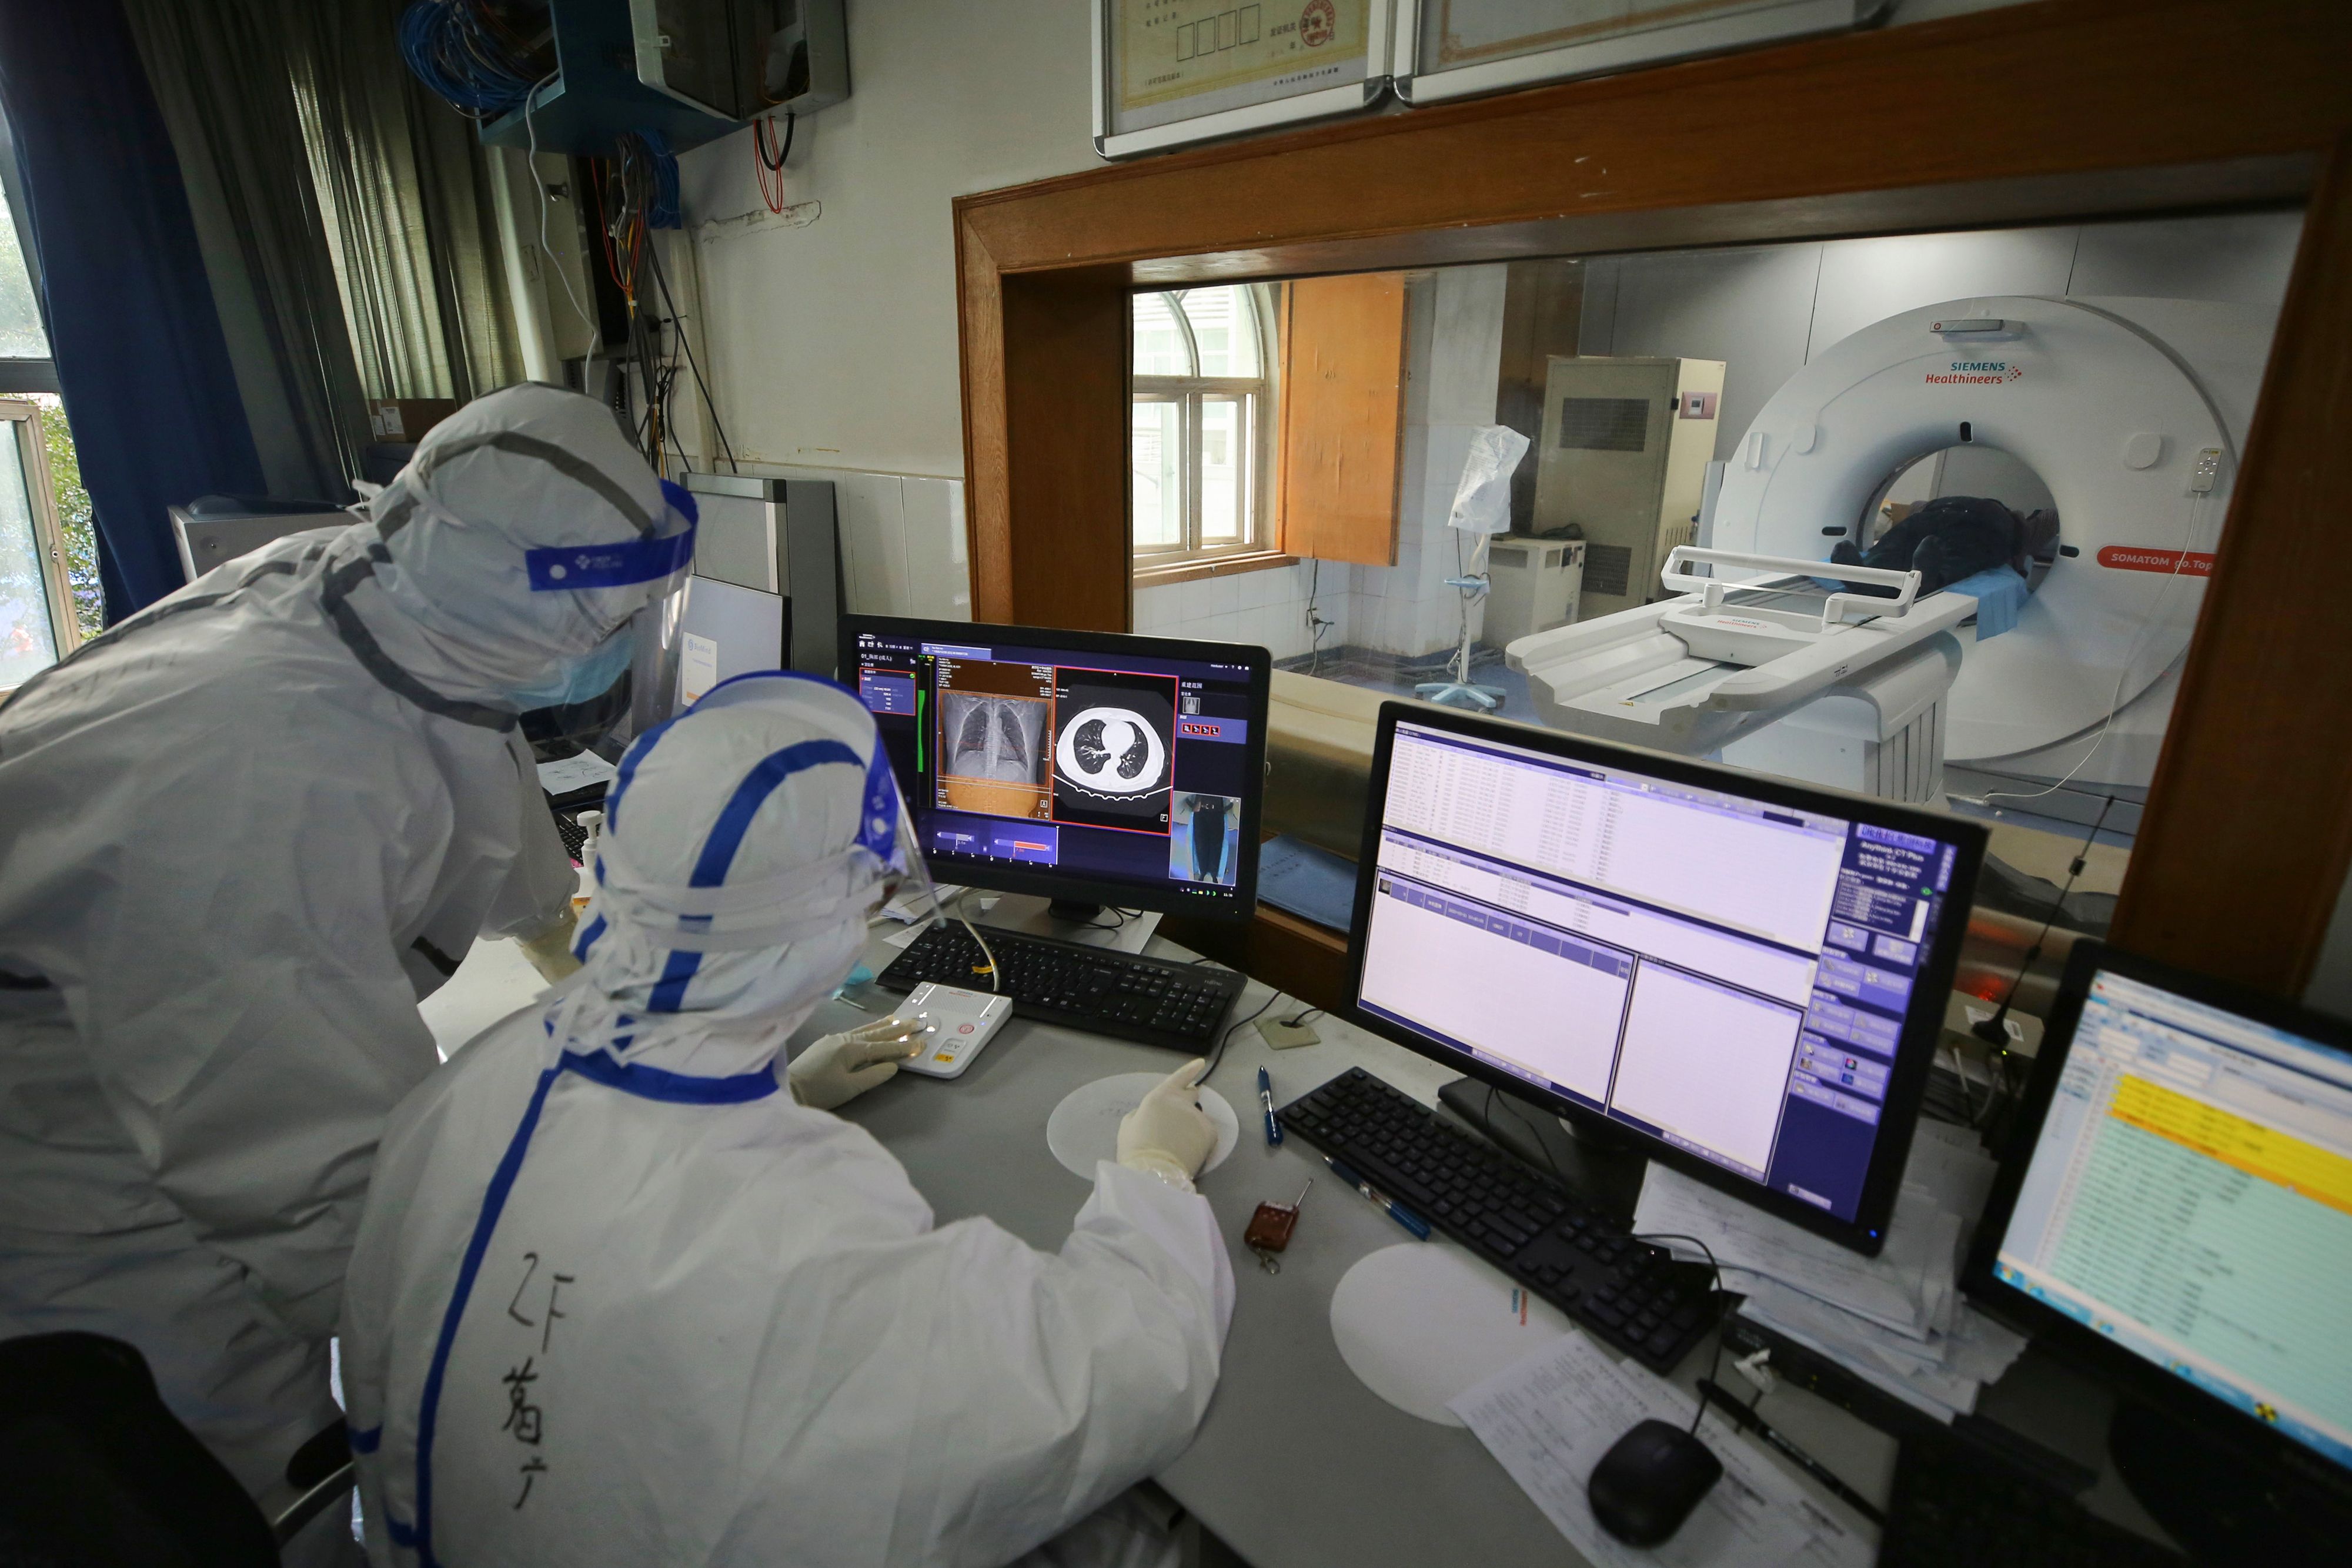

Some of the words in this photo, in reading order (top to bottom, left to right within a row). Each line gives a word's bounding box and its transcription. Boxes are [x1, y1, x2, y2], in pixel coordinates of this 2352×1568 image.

[1950, 362, 2005, 371] SIEMENS
[1926, 373, 2003, 384] Healthineers
[2111, 553, 2170, 566] SOMATOM
[2174, 560, 2213, 571] go.Top
[1717, 620, 1757, 628] Healthineers
